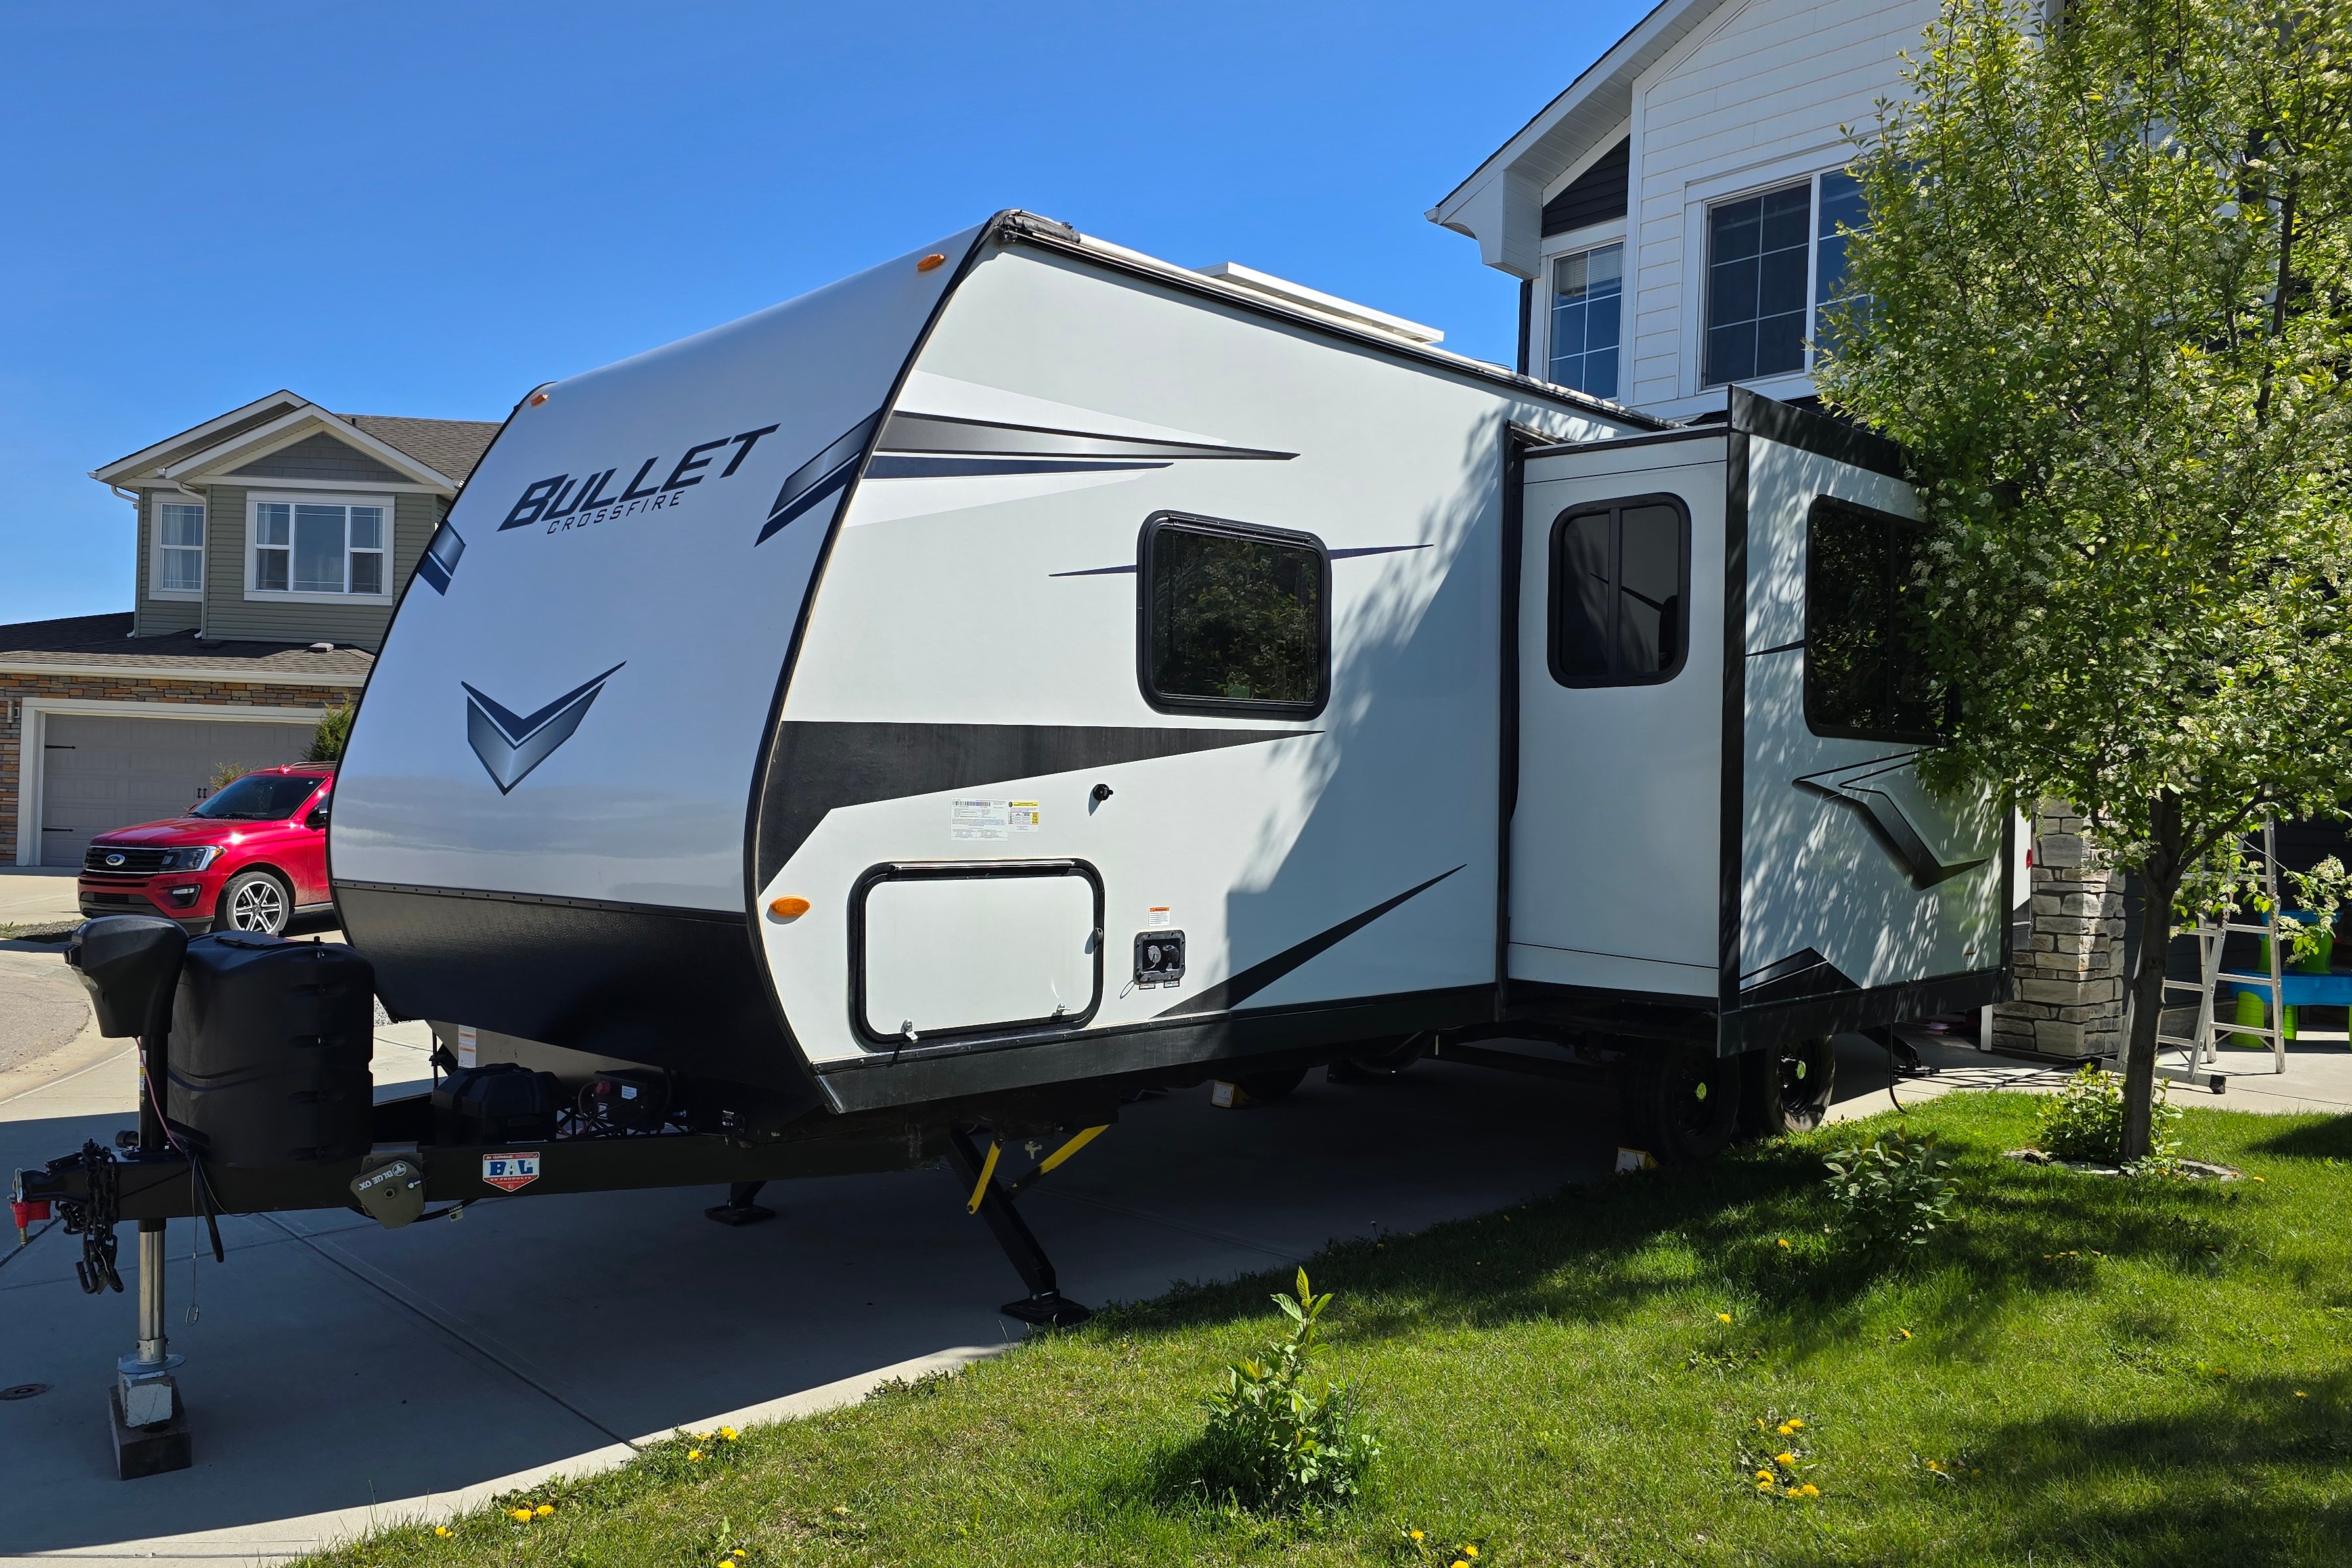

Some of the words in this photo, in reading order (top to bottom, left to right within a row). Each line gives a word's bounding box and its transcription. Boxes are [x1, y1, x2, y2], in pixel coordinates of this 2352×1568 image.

[497, 423, 781, 532] BULLET
[547, 490, 685, 534] CROSSFIRE
[489, 1160, 533, 1176] BAL
[372, 1169, 393, 1185] BLUE
[359, 1180, 372, 1191] OX
